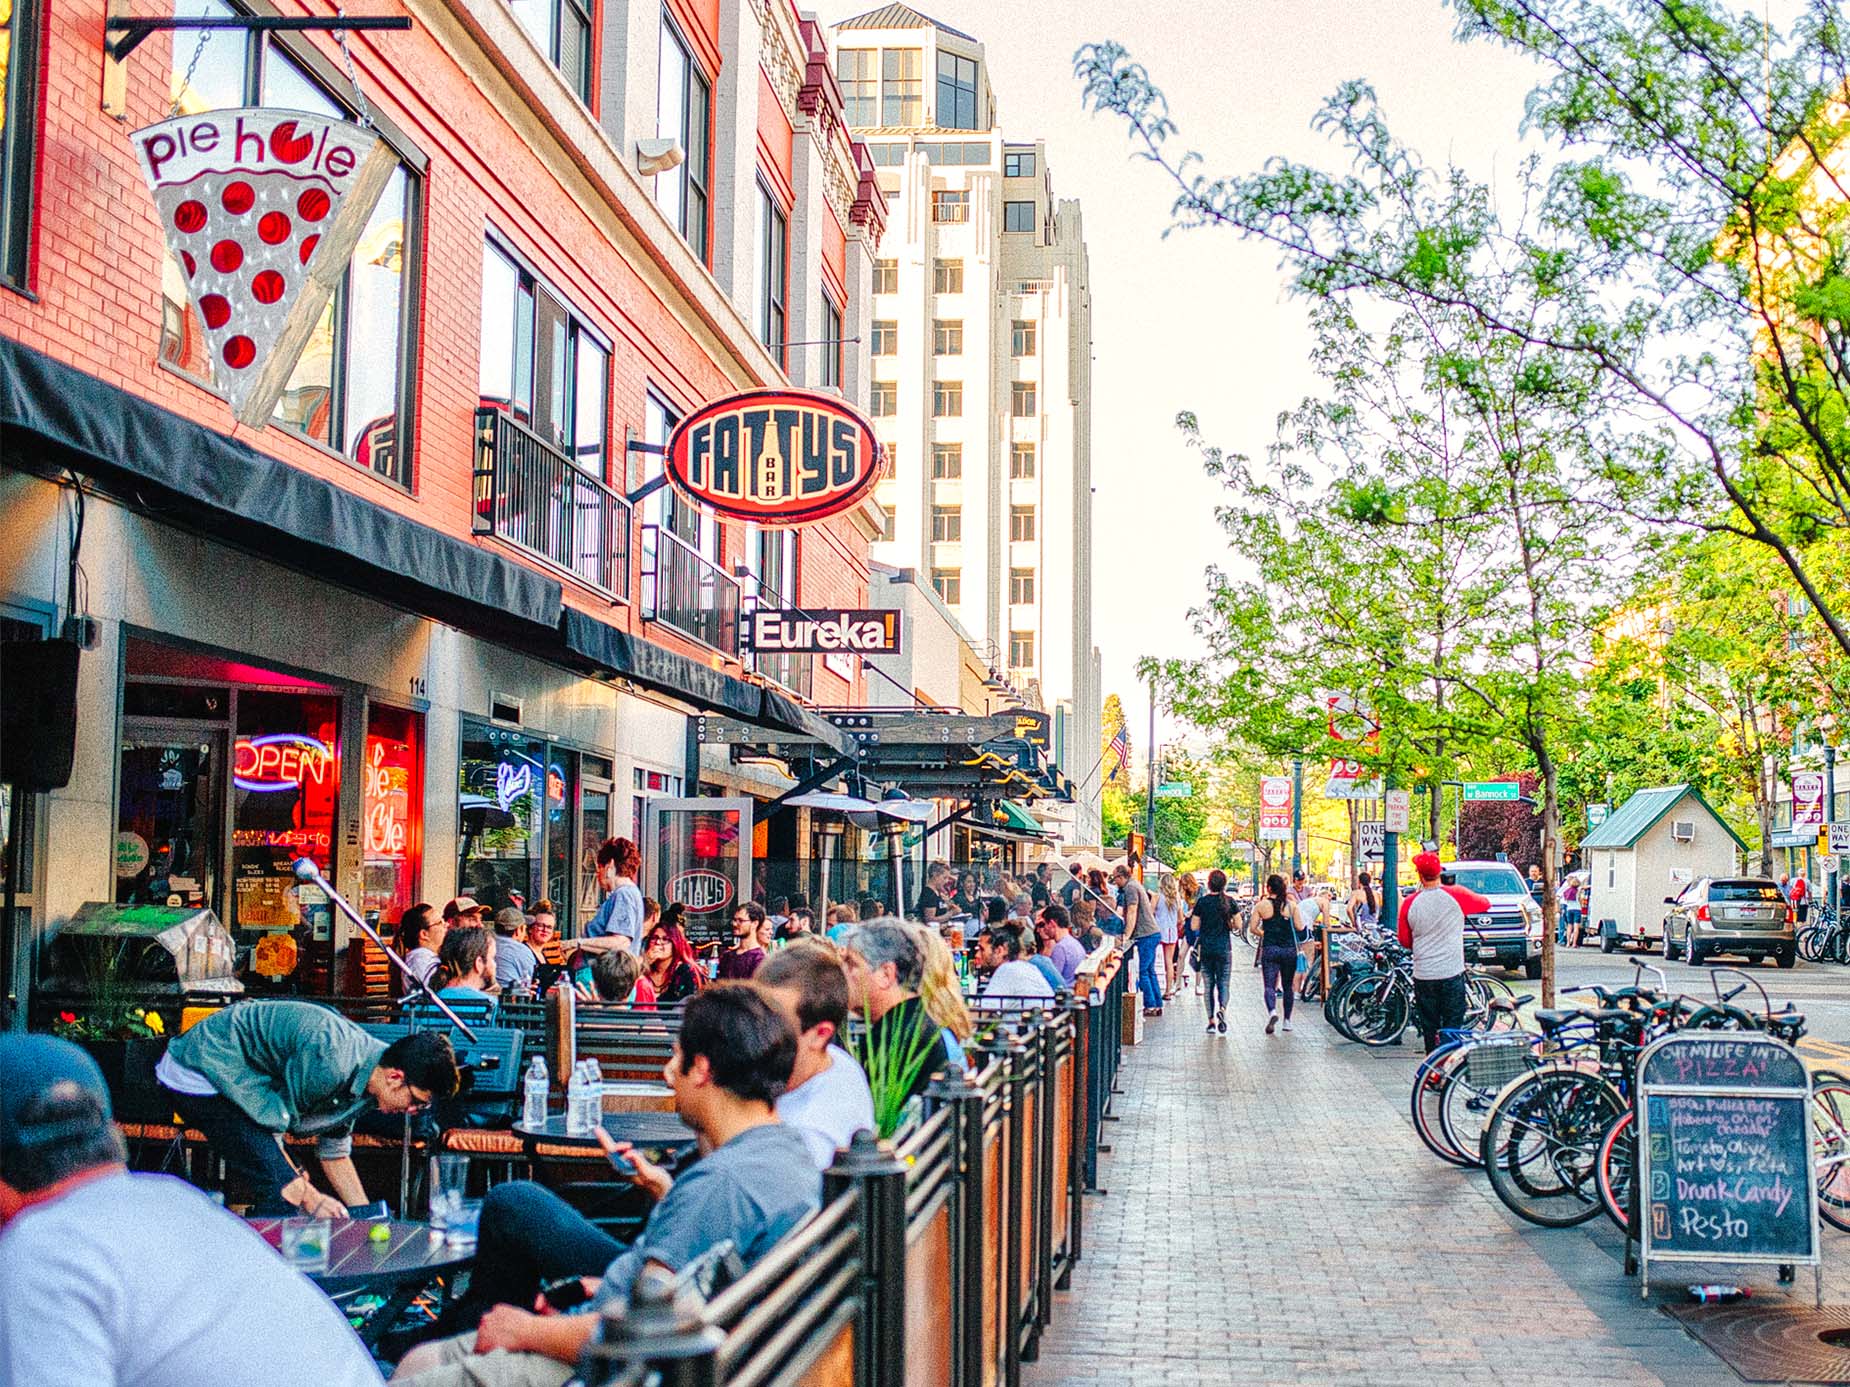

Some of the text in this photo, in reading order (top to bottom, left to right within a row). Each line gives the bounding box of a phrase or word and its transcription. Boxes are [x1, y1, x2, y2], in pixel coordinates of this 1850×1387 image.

[142, 116, 356, 181] pie hole
[692, 409, 858, 496] FATTYS
[766, 457, 775, 497] BAR
[755, 612, 895, 650] Eureka!
[409, 676, 425, 697] 114
[234, 741, 325, 784] OPEN
[1475, 790, 1508, 799] Bannock
[1831, 825, 1848, 833] ONE
[1832, 834, 1849, 842] WAY
[1712, 1043, 1745, 1059] LIFE
[1677, 1178, 1734, 1201] Drunk
[1734, 1175, 1793, 1218] Candy
[1681, 1205, 1749, 1241] Pesto
